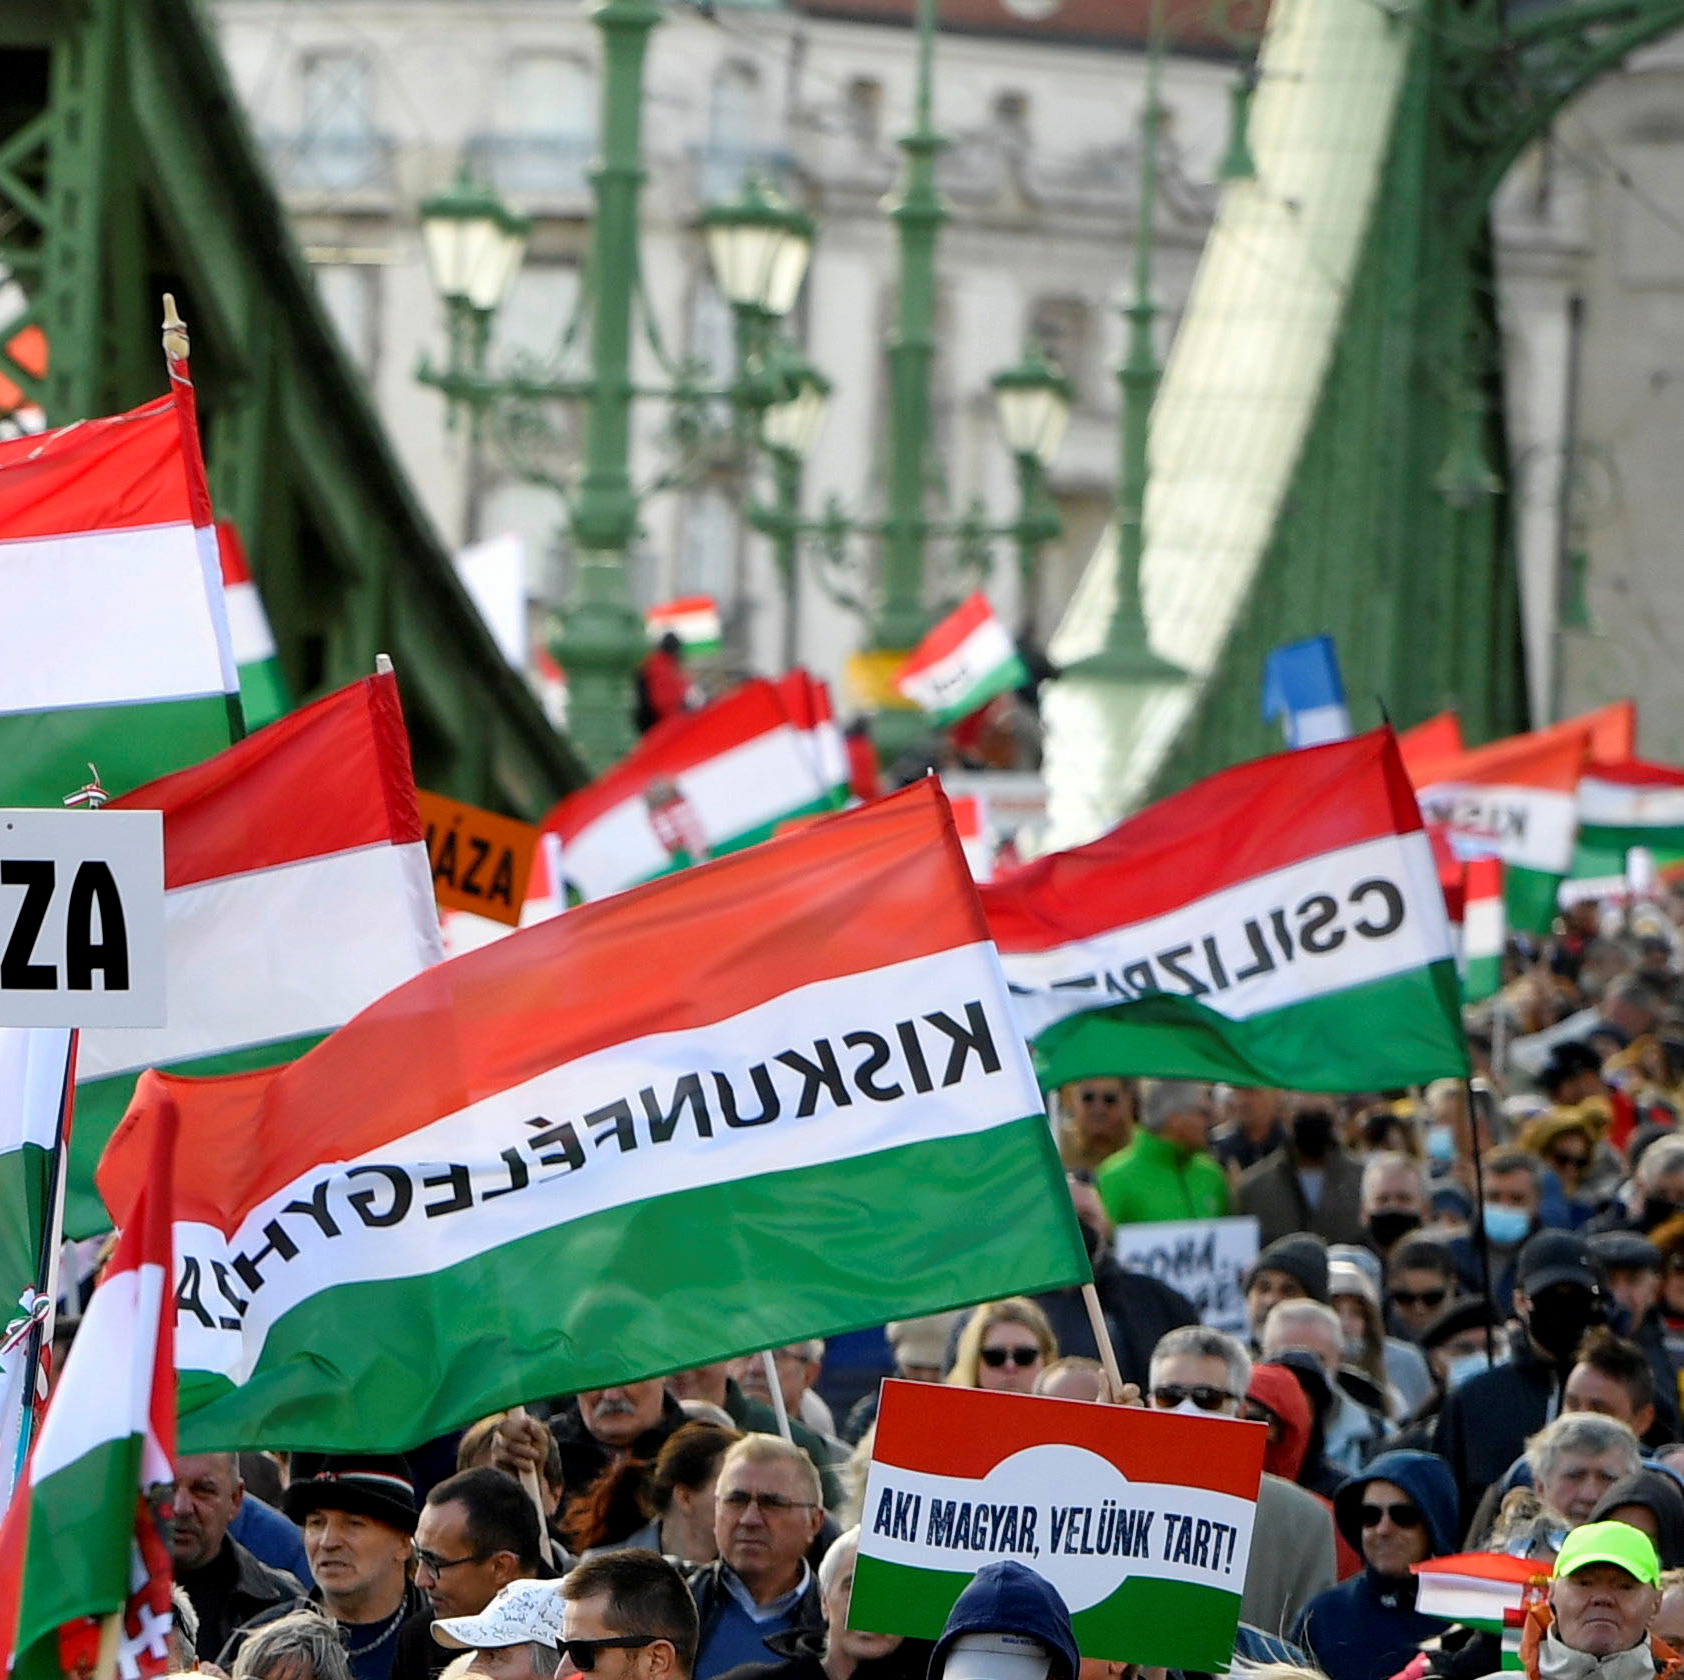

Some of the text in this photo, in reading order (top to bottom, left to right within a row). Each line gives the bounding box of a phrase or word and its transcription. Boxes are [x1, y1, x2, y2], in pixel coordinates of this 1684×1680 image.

[873, 1487, 1238, 1575] AKI MAGYAR, VELÜNK TART!
